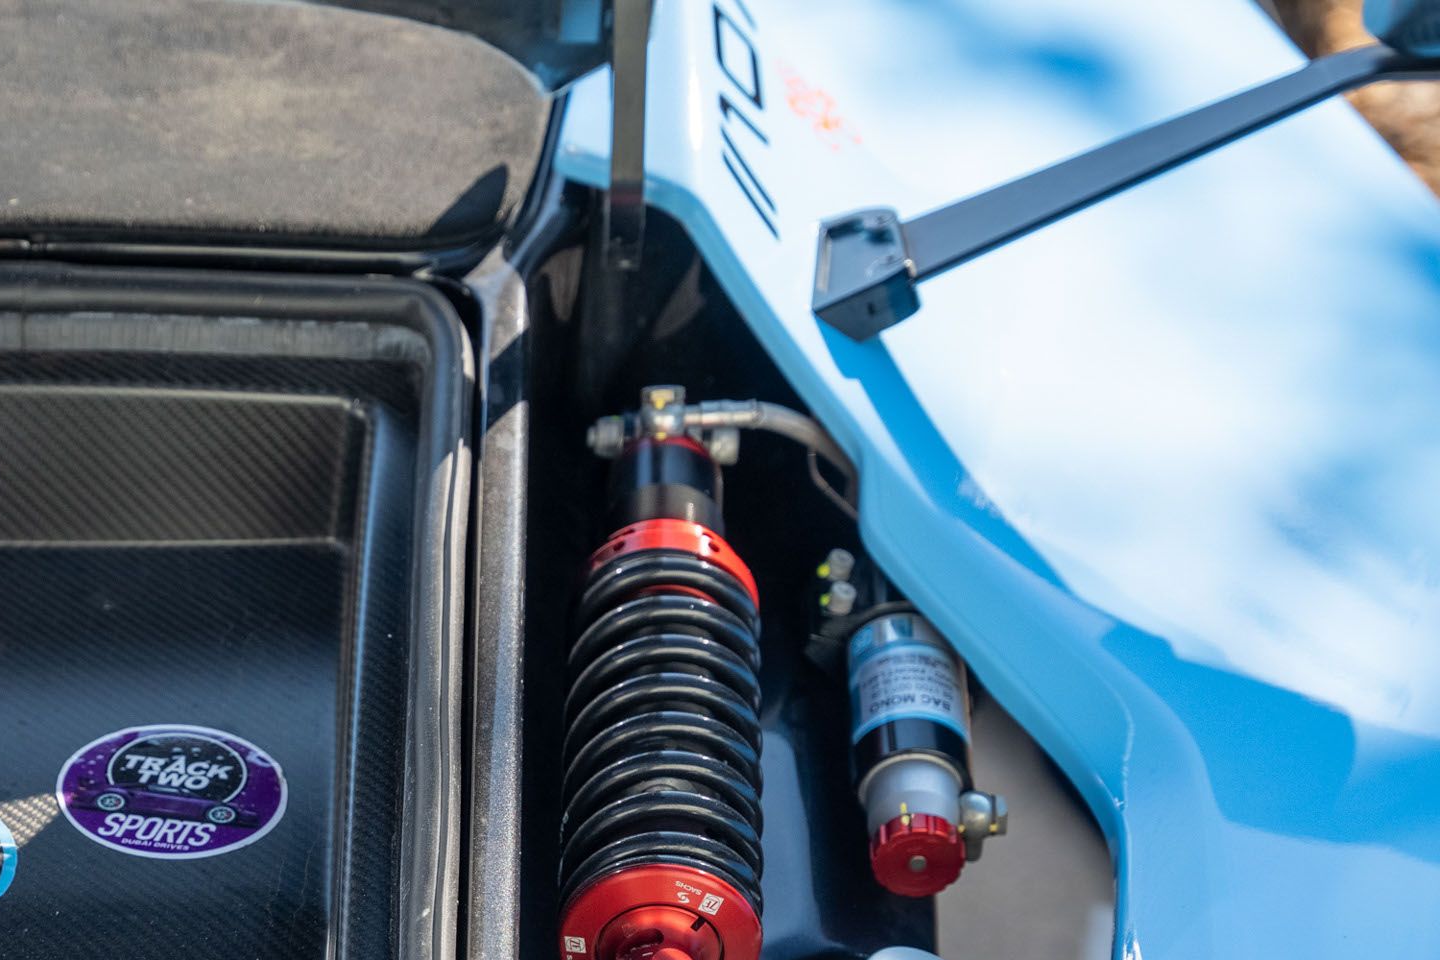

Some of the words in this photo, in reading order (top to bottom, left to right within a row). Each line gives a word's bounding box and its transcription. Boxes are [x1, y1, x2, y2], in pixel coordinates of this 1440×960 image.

[125, 754, 234, 779] TRACK
[138, 769, 210, 790] TWO
[98, 813, 216, 846] SPORTS
[121, 838, 152, 847] DUBAI
[153, 842, 191, 851] DRIVES
[675, 880, 703, 896] SACHS
